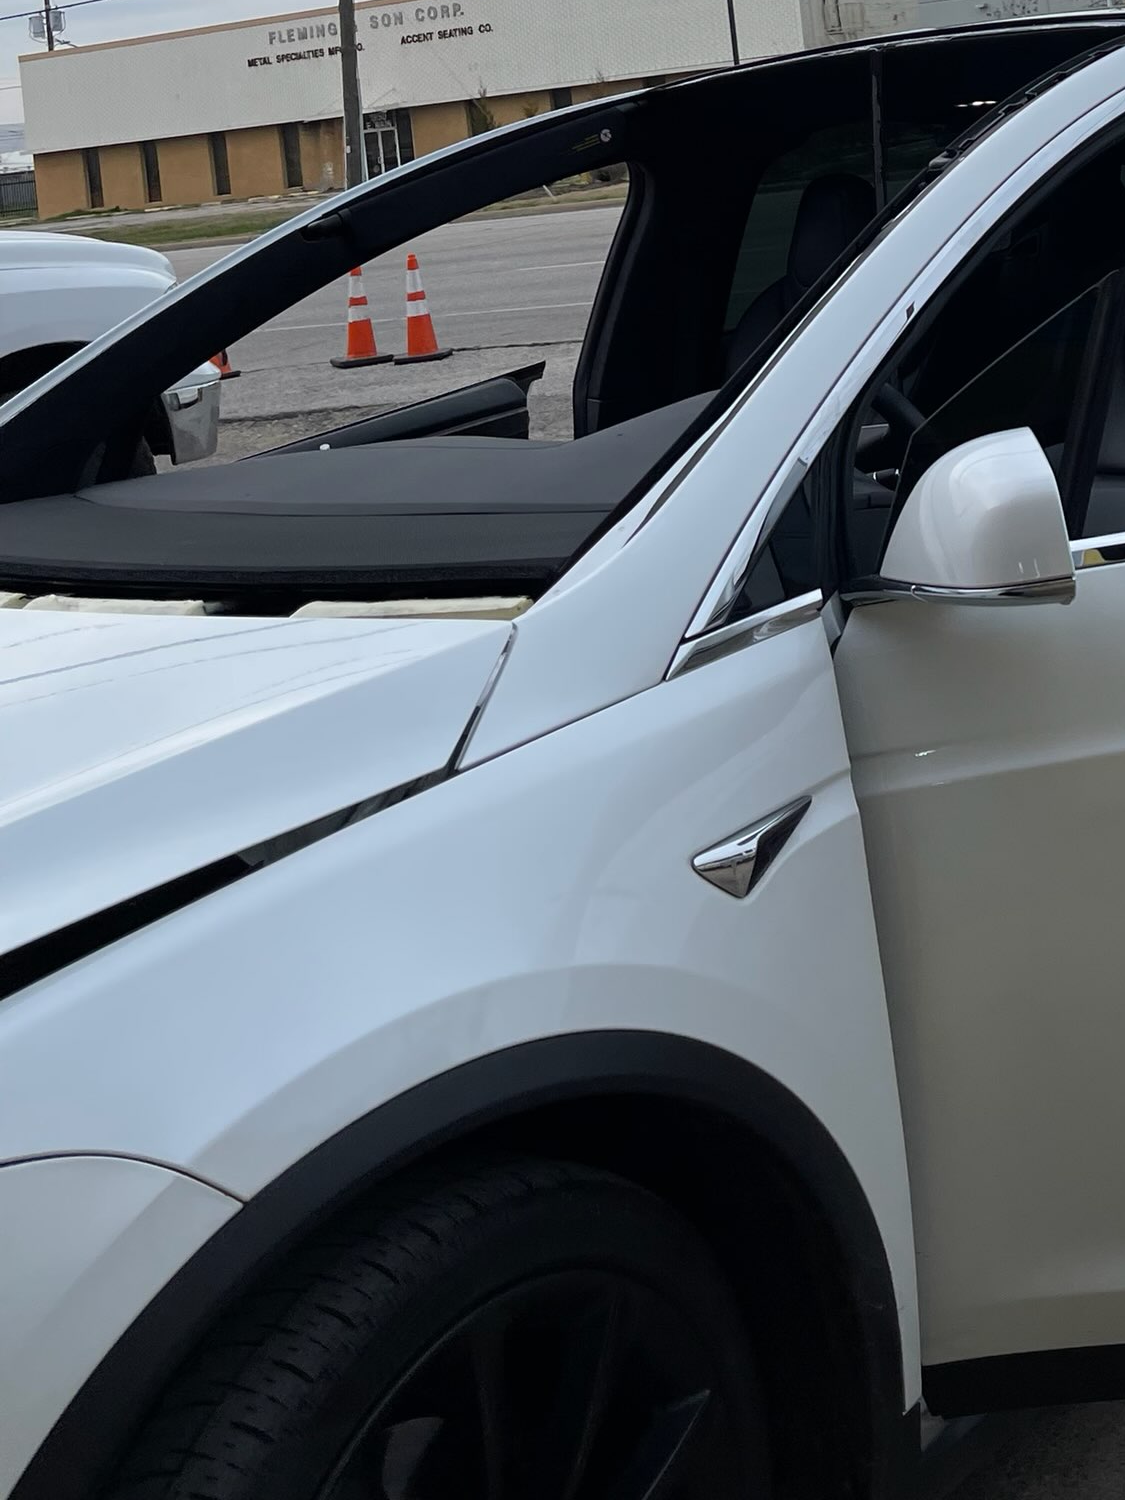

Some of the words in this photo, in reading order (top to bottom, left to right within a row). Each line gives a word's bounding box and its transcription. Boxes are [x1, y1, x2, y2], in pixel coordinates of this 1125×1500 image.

[268, 22, 338, 45] FLEMING
[369, 11, 403, 29] SON
[415, 2, 464, 22] CORP.
[401, 32, 434, 45] ACCENT
[438, 26, 473, 40] SEATING
[478, 23, 493, 34] CO.
[247, 56, 273, 67] METAL
[276, 49, 324, 63] SPECIALTIES
[328, 45, 342, 56] MF
